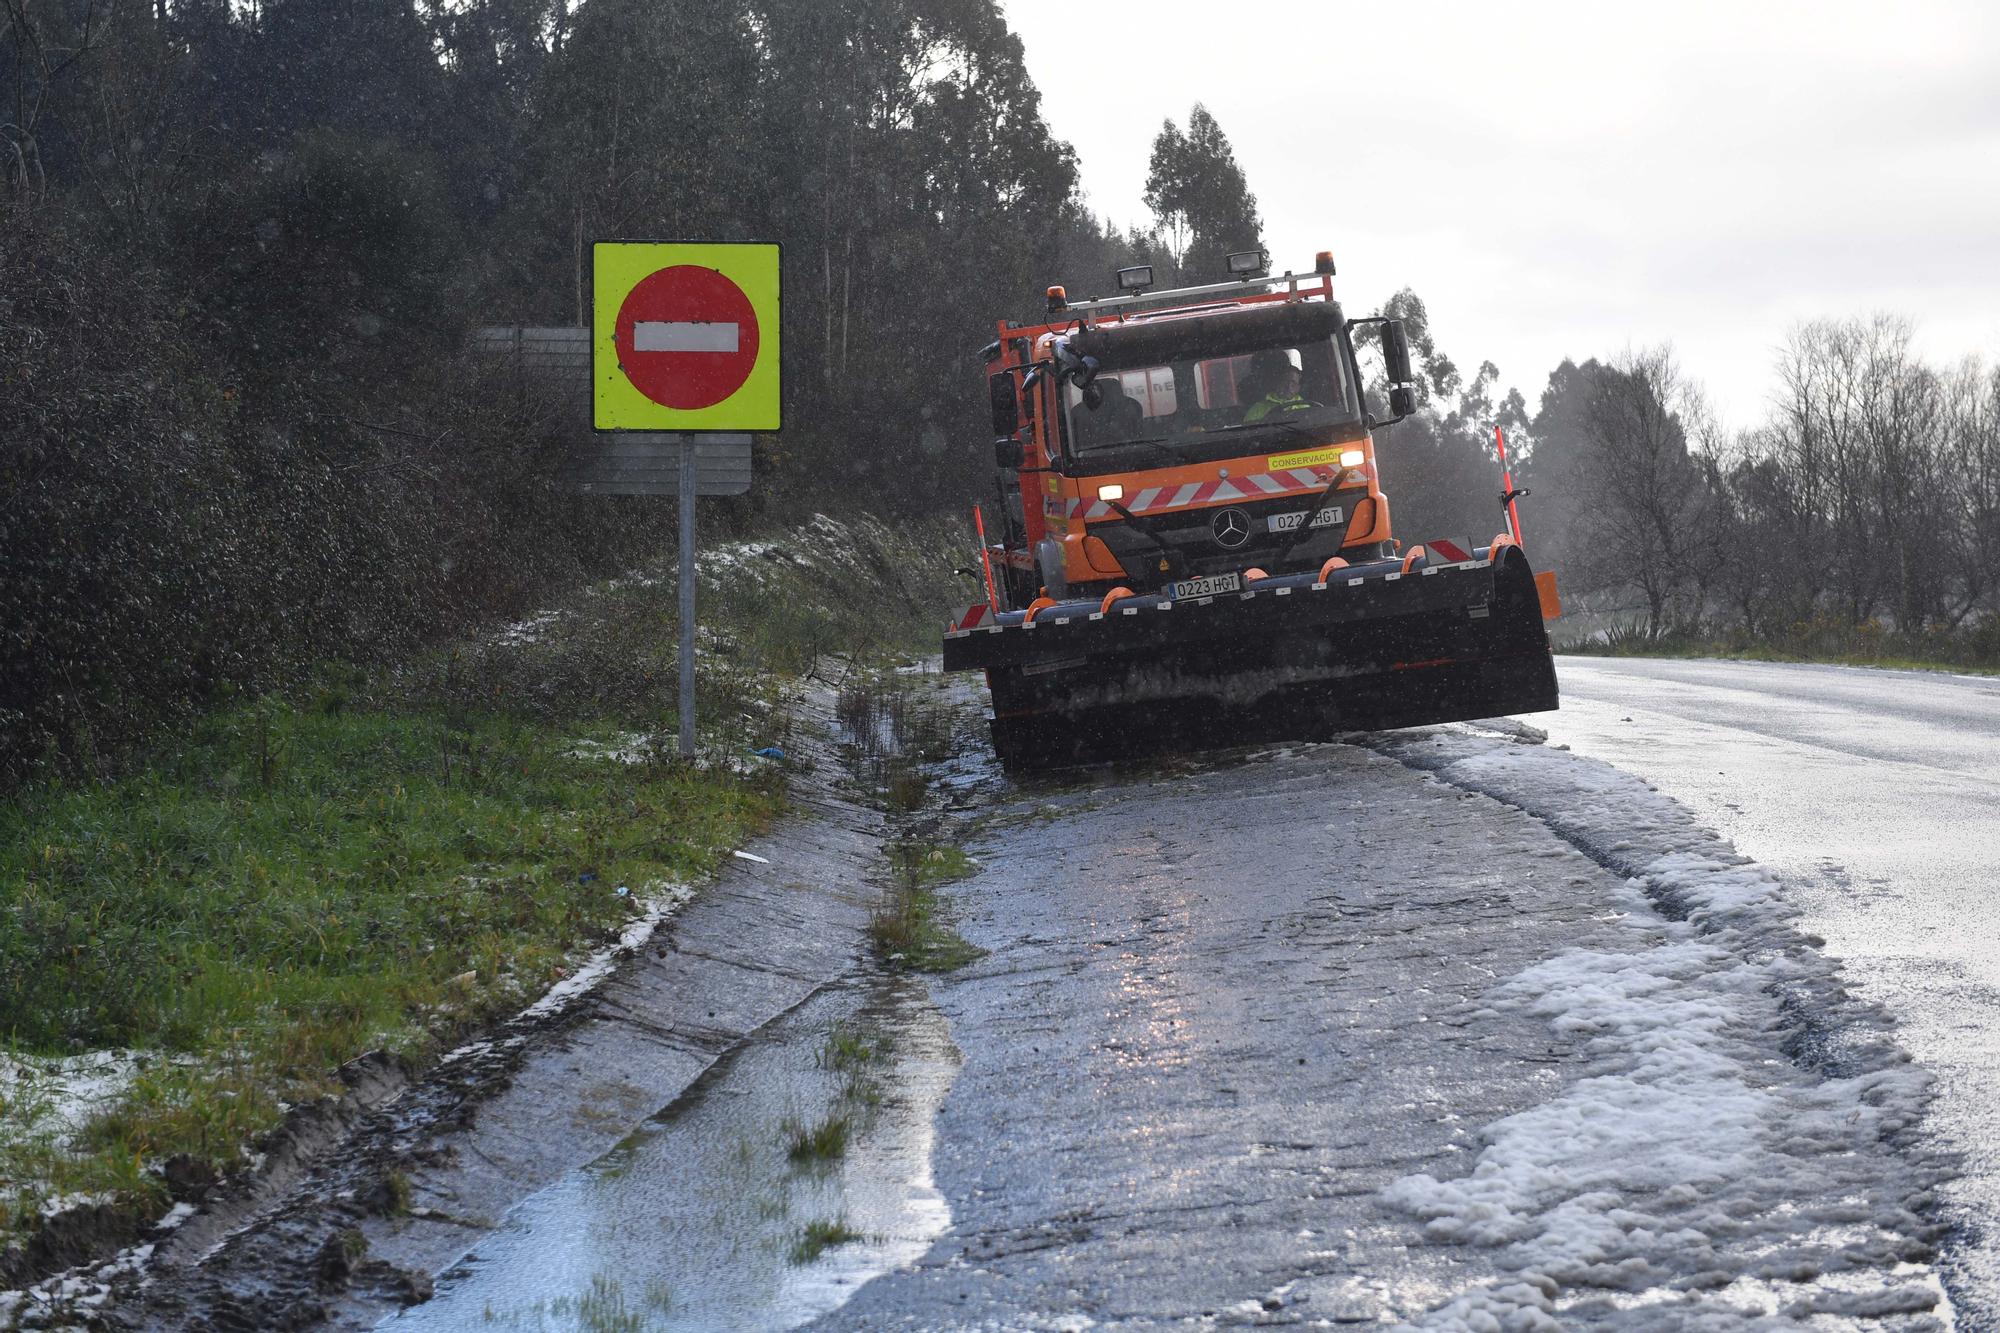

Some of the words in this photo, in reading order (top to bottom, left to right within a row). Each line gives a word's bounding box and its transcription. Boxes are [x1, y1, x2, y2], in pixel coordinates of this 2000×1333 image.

[1278, 514, 1305, 529] 022
[1315, 509, 1338, 524] HGT
[1177, 580, 1211, 597] 0223
[1213, 575, 1236, 592] HGT
